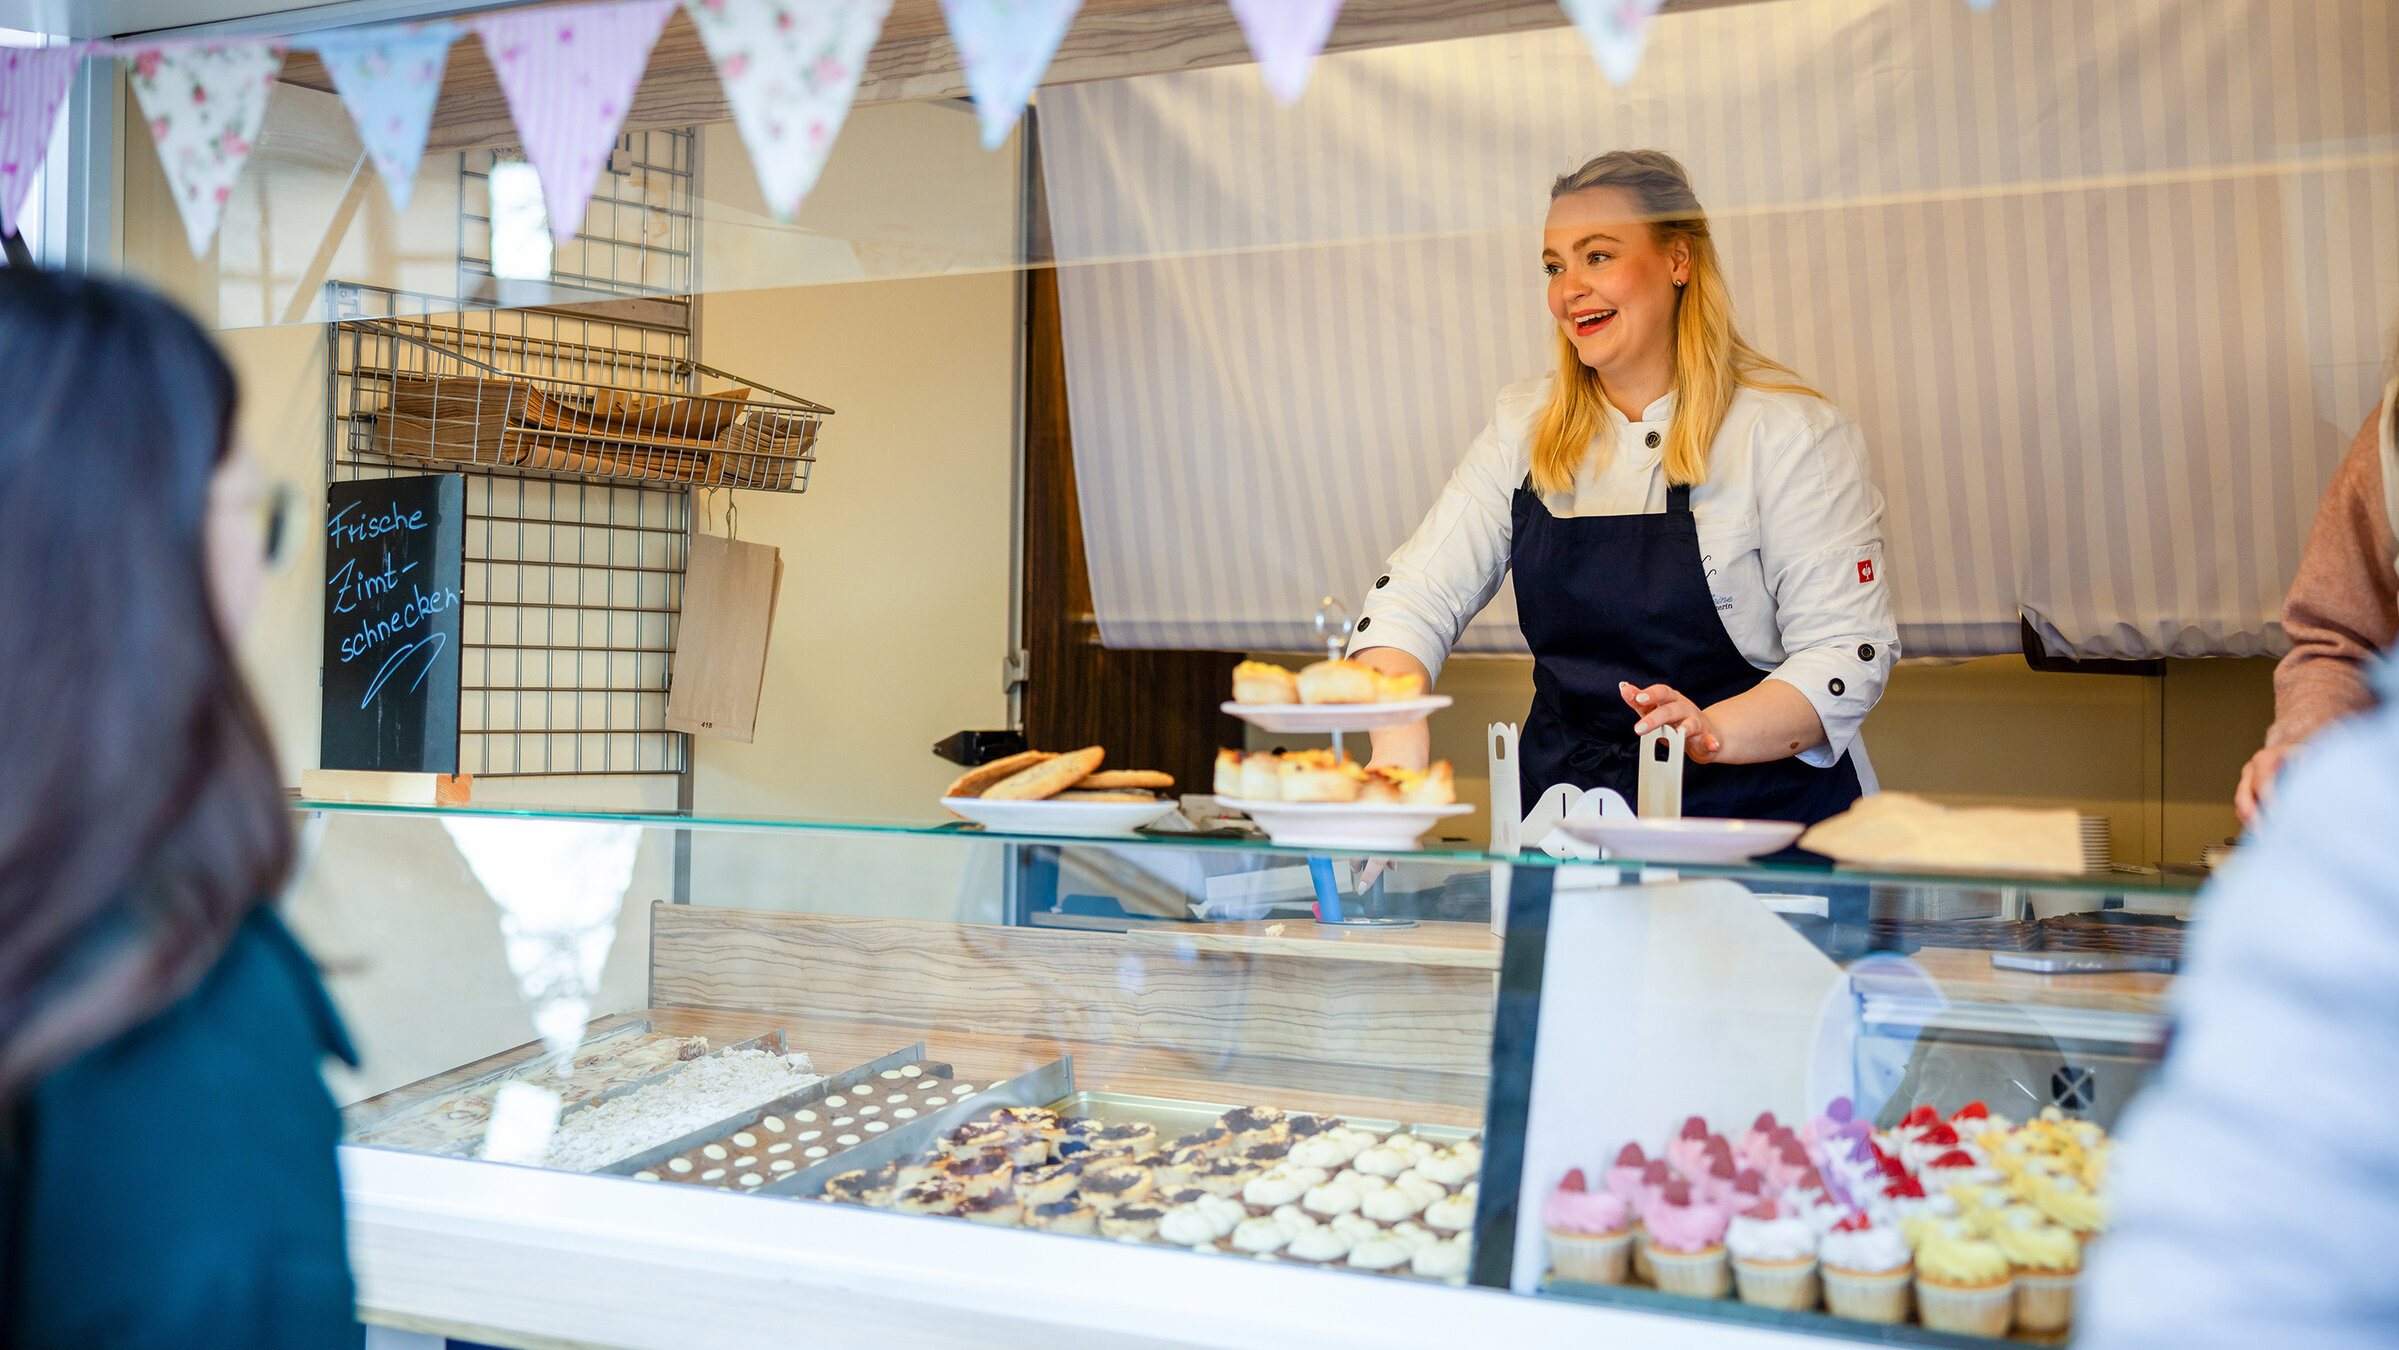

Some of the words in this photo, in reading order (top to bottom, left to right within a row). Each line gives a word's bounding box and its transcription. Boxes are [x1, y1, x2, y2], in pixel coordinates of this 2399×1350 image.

[328, 500, 428, 549] Frische
[329, 552, 418, 614] Zimt-
[341, 584, 458, 662] schnecken
